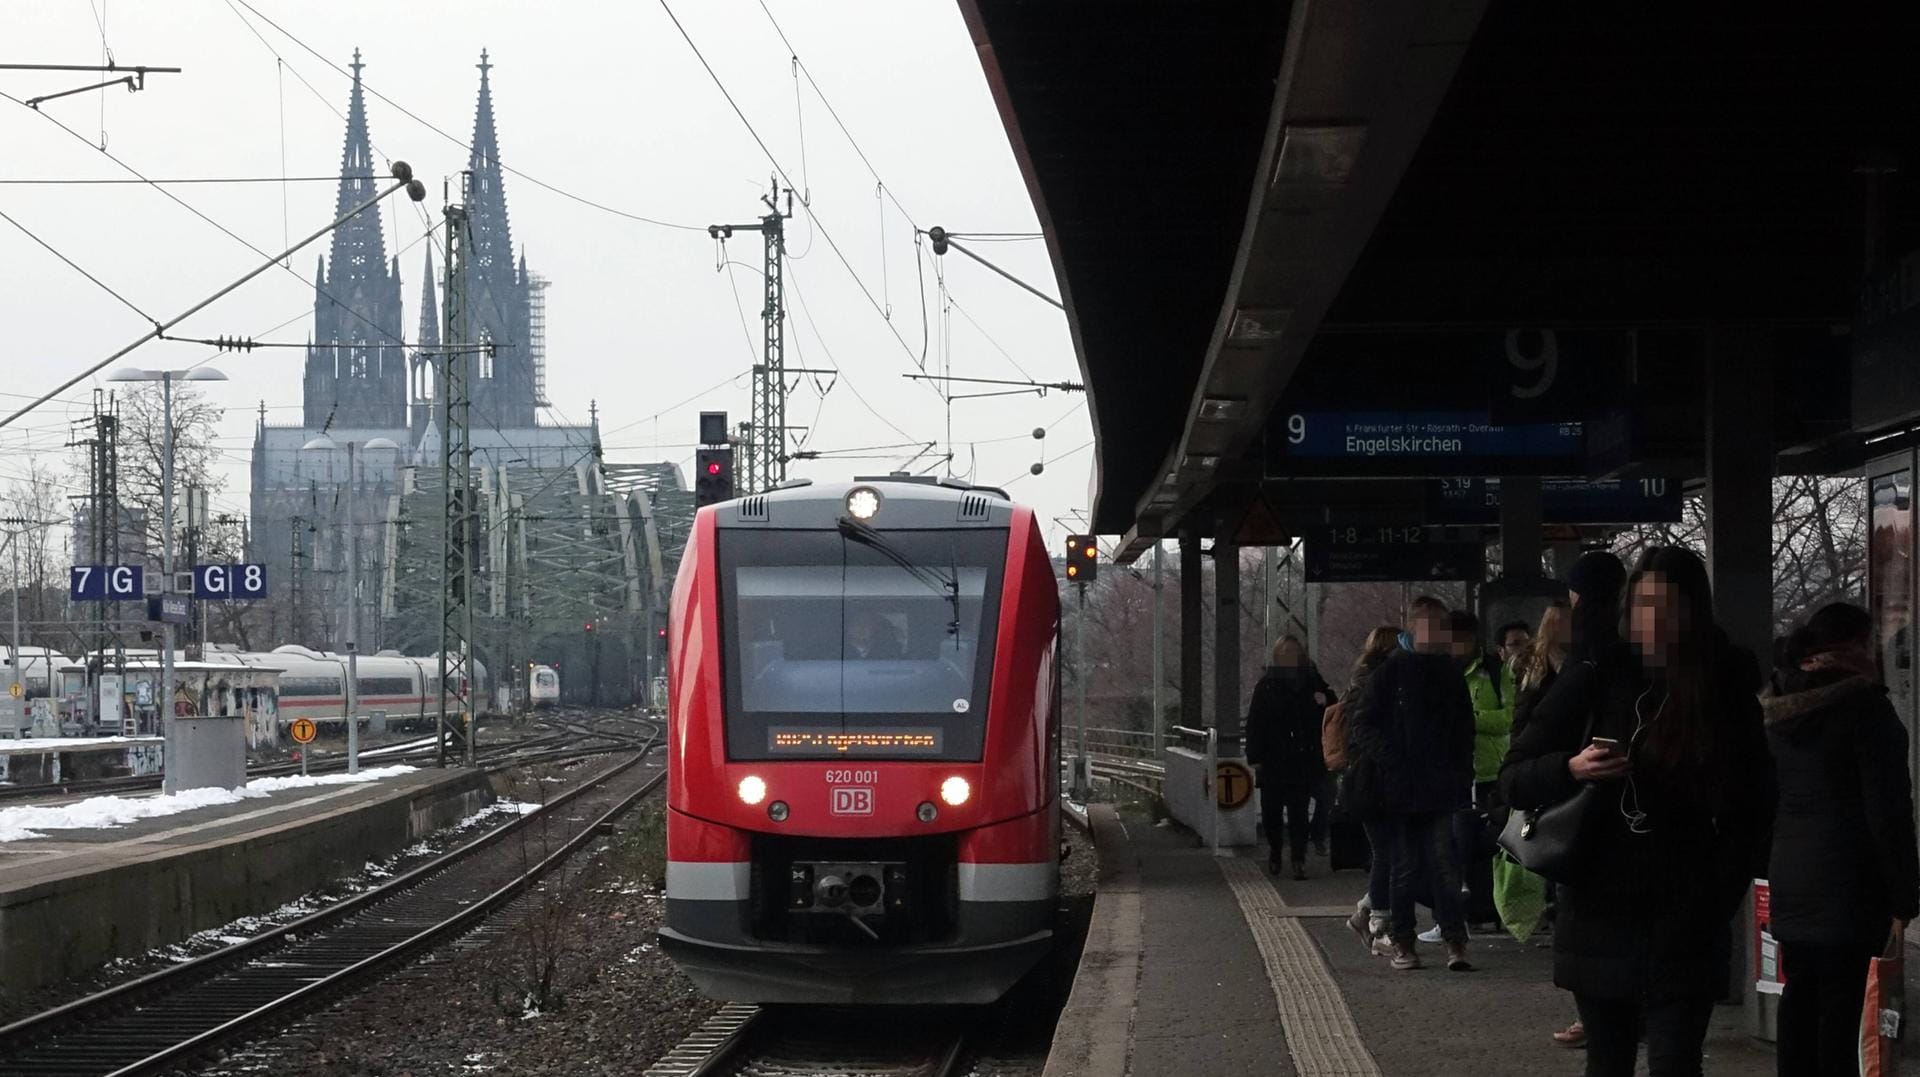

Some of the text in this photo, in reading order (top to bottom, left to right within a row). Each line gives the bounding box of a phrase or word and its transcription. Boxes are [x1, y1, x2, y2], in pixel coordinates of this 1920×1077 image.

[1505, 328, 1559, 400] 9
[1287, 414, 1306, 444] 9
[1353, 424, 1402, 433] Frankfurter
[1345, 435, 1462, 456] Engelskirchen
[1329, 527, 1358, 545] 1-8
[1377, 526, 1421, 545] 11-12
[75, 566, 133, 593] 7 G
[204, 564, 263, 593] G 8
[825, 770, 878, 784] 620 001
[835, 789, 870, 812] DB
